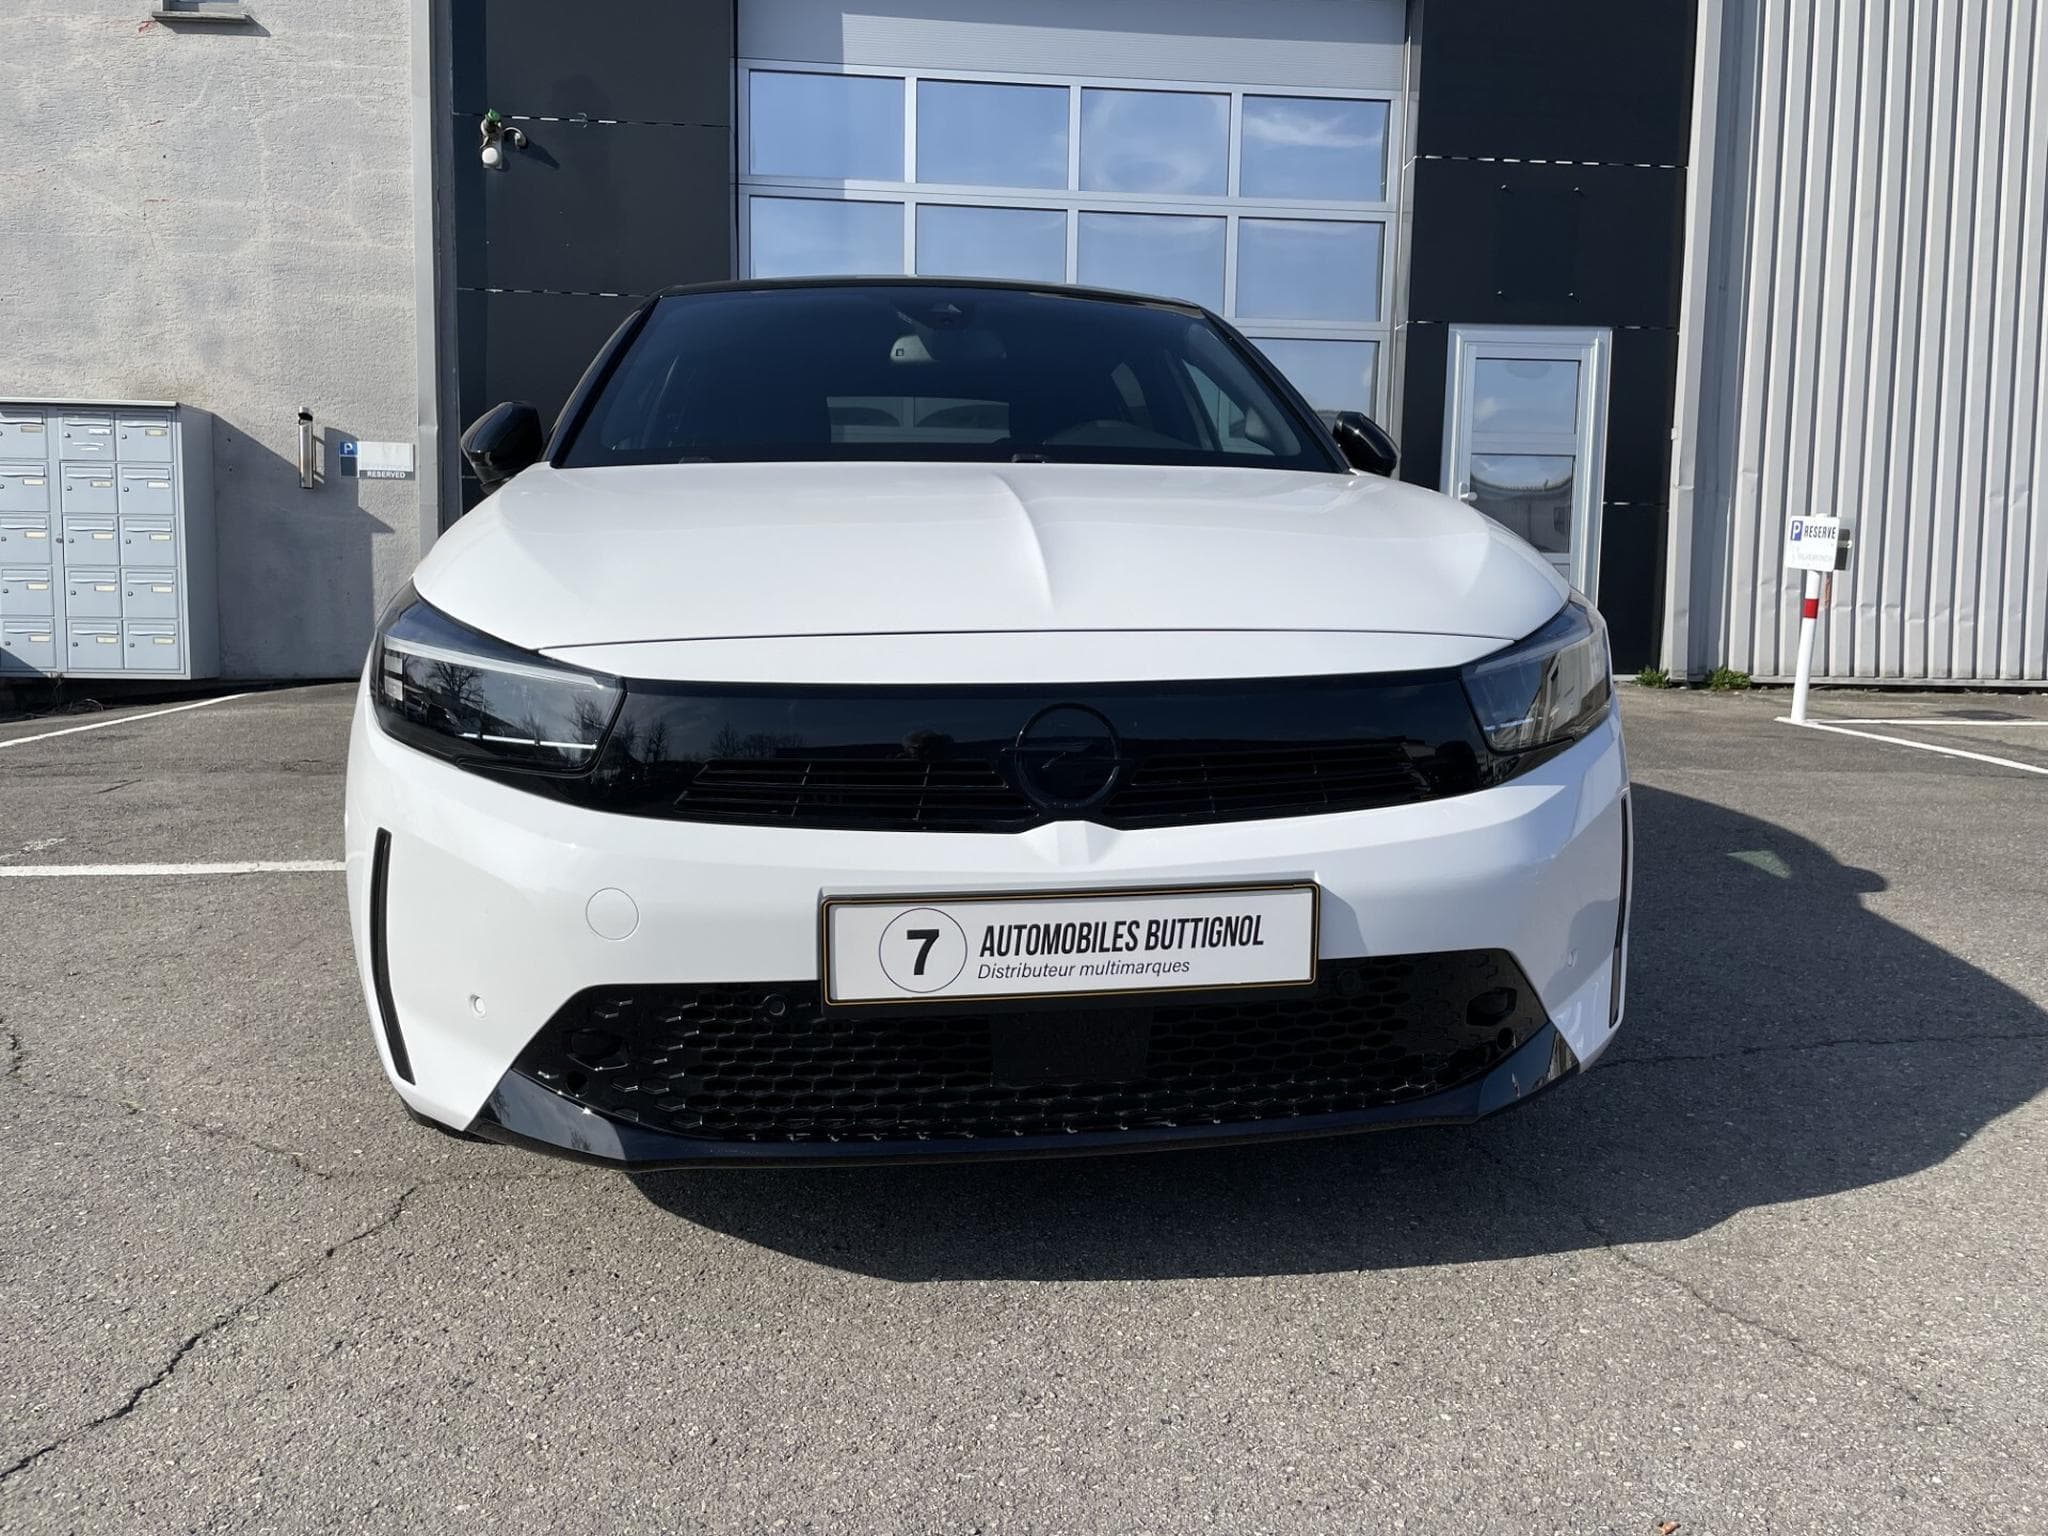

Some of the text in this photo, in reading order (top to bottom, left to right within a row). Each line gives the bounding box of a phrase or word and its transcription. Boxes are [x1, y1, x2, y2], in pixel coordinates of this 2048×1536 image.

[344, 442, 354, 454] P
[367, 470, 406, 479] RESERVED
[979, 914, 1264, 957] AUTOMOBILES BUTTIGNOL
[906, 929, 940, 976] 7
[978, 960, 1191, 980] Distributeur multimarques
